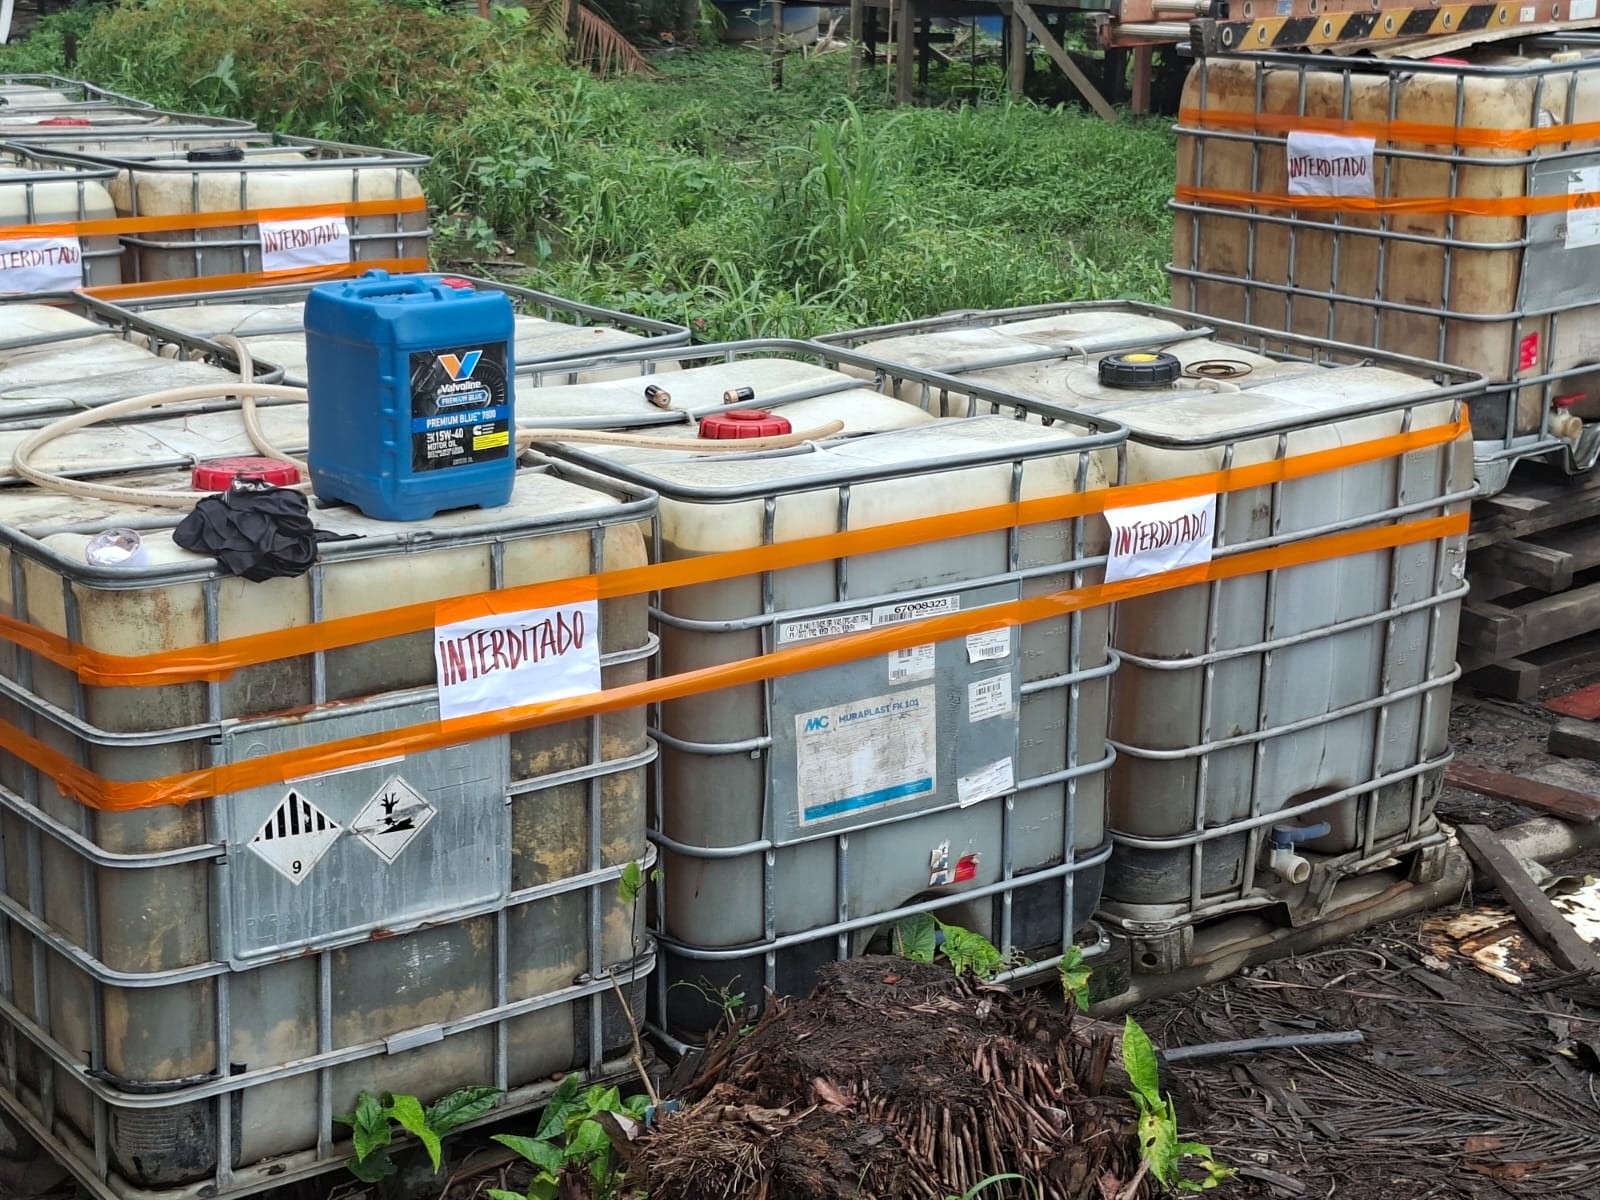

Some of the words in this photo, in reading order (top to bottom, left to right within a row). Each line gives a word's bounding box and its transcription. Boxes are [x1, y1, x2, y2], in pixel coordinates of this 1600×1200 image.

[1289, 154, 1367, 179] INTERDITADO
[263, 222, 340, 254] INTERDITADO
[440, 381, 482, 393] Valvoline
[441, 396, 468, 406] PREMIUM
[468, 393, 483, 401] BLUE
[427, 417, 459, 429] PREMIUM
[436, 428, 464, 442] 15W-40
[427, 441, 447, 451] MOTOR
[448, 439, 458, 448] OIL
[1114, 510, 1208, 558] INTERDITADO
[894, 599, 948, 614] 67008323
[439, 610, 585, 687] INTERDITADO
[892, 702, 904, 711] FK
[905, 698, 920, 708] 101
[804, 715, 830, 733] MC
[291, 860, 302, 874] 9
